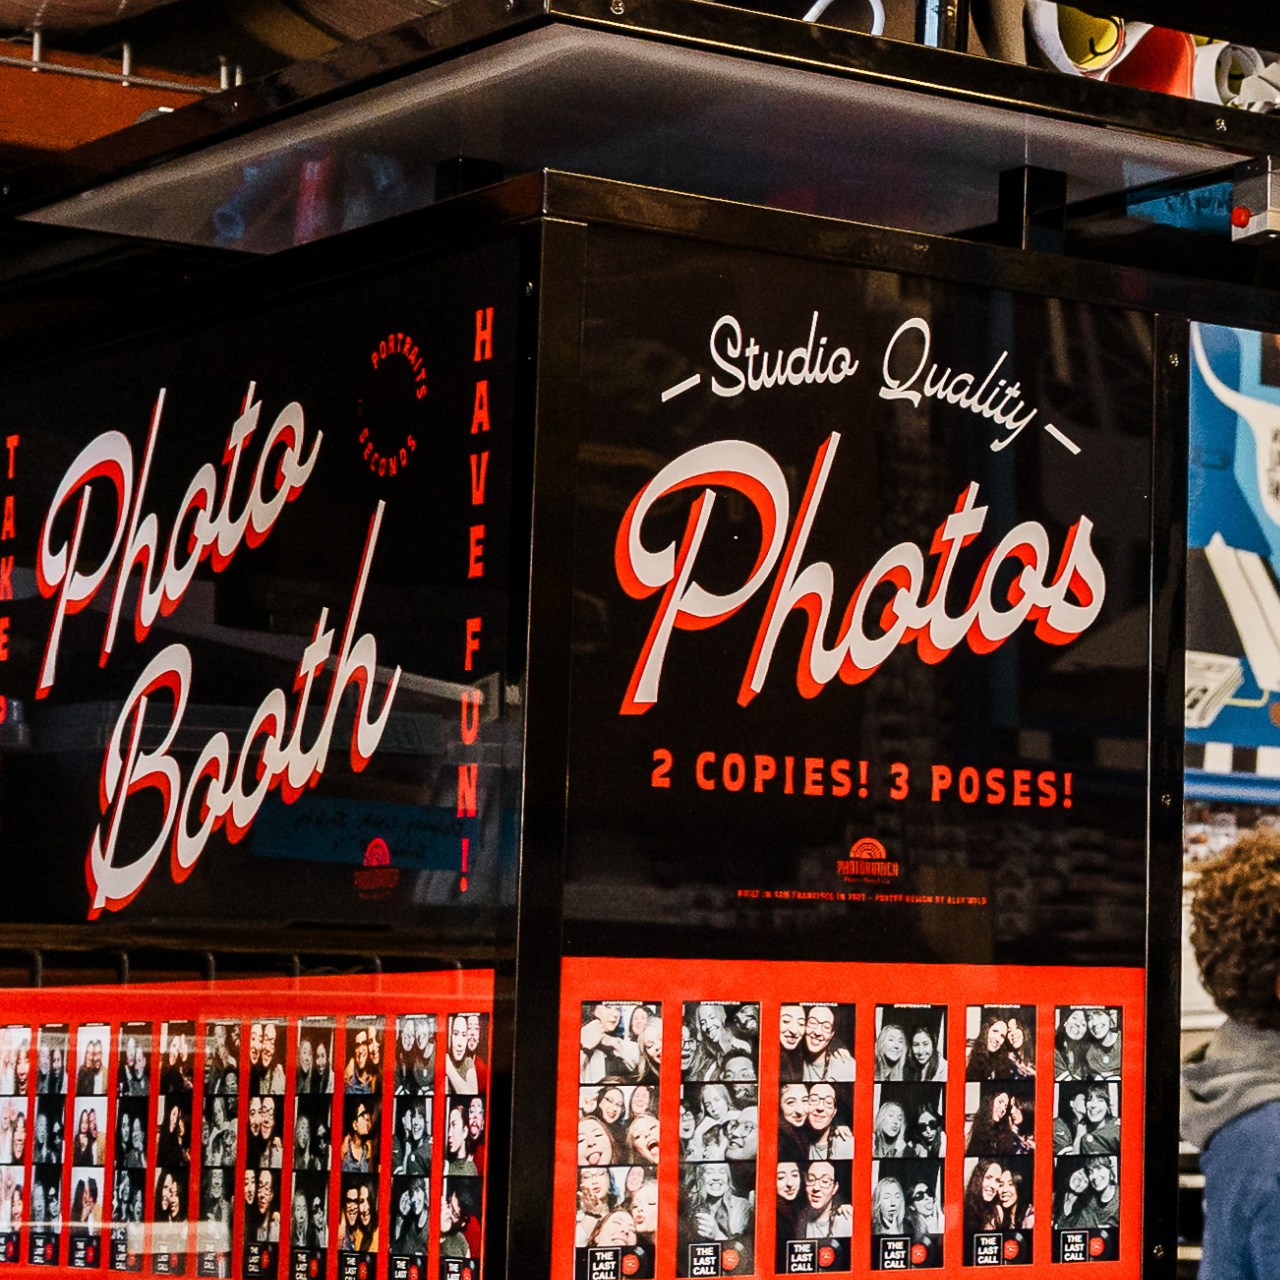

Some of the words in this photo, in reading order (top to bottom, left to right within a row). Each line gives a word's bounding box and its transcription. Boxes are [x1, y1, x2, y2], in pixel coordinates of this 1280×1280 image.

[371, 332, 427, 399] PORTRAITS
[710, 310, 858, 397] Studio
[880, 318, 1037, 452] Quality
[467, 307, 495, 579] HAVE
[359, 427, 416, 477] SECONDS
[36, 381, 323, 700] Photo
[614, 431, 1106, 715] Photos
[85, 500, 401, 920] Booth
[456, 616, 481, 892] FUN!
[651, 749, 674, 789] 2
[696, 752, 871, 799] COPIES!
[890, 763, 910, 797] 3
[931, 765, 1075, 808] POSES!
[980, 1237, 996, 1246] THE
[1067, 1235, 1083, 1243] THE
[794, 1244, 811, 1253] THE
[887, 1242, 903, 1250] THE
[1065, 1243, 1085, 1252] LAST
[696, 1247, 713, 1256] THE
[885, 1251, 905, 1260] LAST
[978, 1247, 998, 1255] LAST
[595, 1252, 613, 1261] THE
[791, 1253, 812, 1262] LAST
[978, 1256, 999, 1264] CALL
[1064, 1252, 1085, 1261] CALL
[396, 1260, 405, 1270] THE
[593, 1261, 615, 1270] LAST
[693, 1257, 715, 1266] LAST
[884, 1260, 905, 1269] CALL
[693, 1267, 716, 1276] CALL
[791, 1263, 812, 1272] CALL
[395, 1270, 407, 1279] LAST
[593, 1272, 616, 1280] CALL
